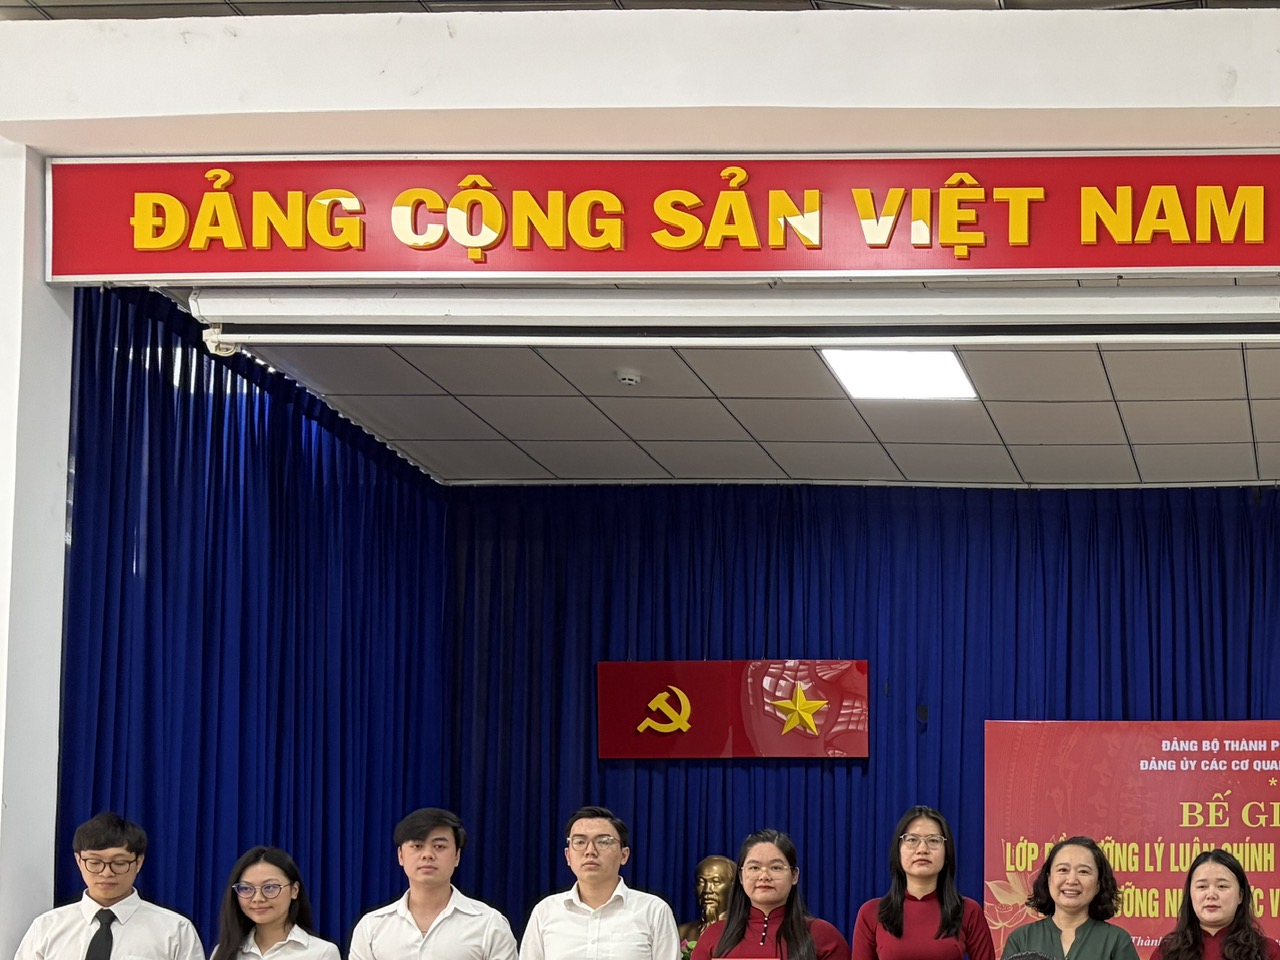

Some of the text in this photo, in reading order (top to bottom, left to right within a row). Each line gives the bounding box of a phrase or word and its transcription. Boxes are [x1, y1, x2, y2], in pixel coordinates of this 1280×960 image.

[130, 168, 366, 251] ĐẢNG
[390, 174, 625, 262] CỘNG
[651, 166, 822, 250] SẢN
[851, 172, 1046, 259] VIỆT
[1081, 185, 1265, 245] NAM
[1161, 736, 1199, 752] ĐẢNG
[1202, 737, 1220, 754] BỘ
[1223, 737, 1267, 752] THÀNH
[1139, 756, 1176, 771] ĐẢNG
[1180, 756, 1197, 771] ỦY
[1201, 757, 1227, 771] CÁC
[1231, 758, 1250, 771] CƠ
[1178, 789, 1232, 828] BẾ
[1005, 836, 1040, 872] LỚP
[1144, 837, 1166, 872] LÝ
